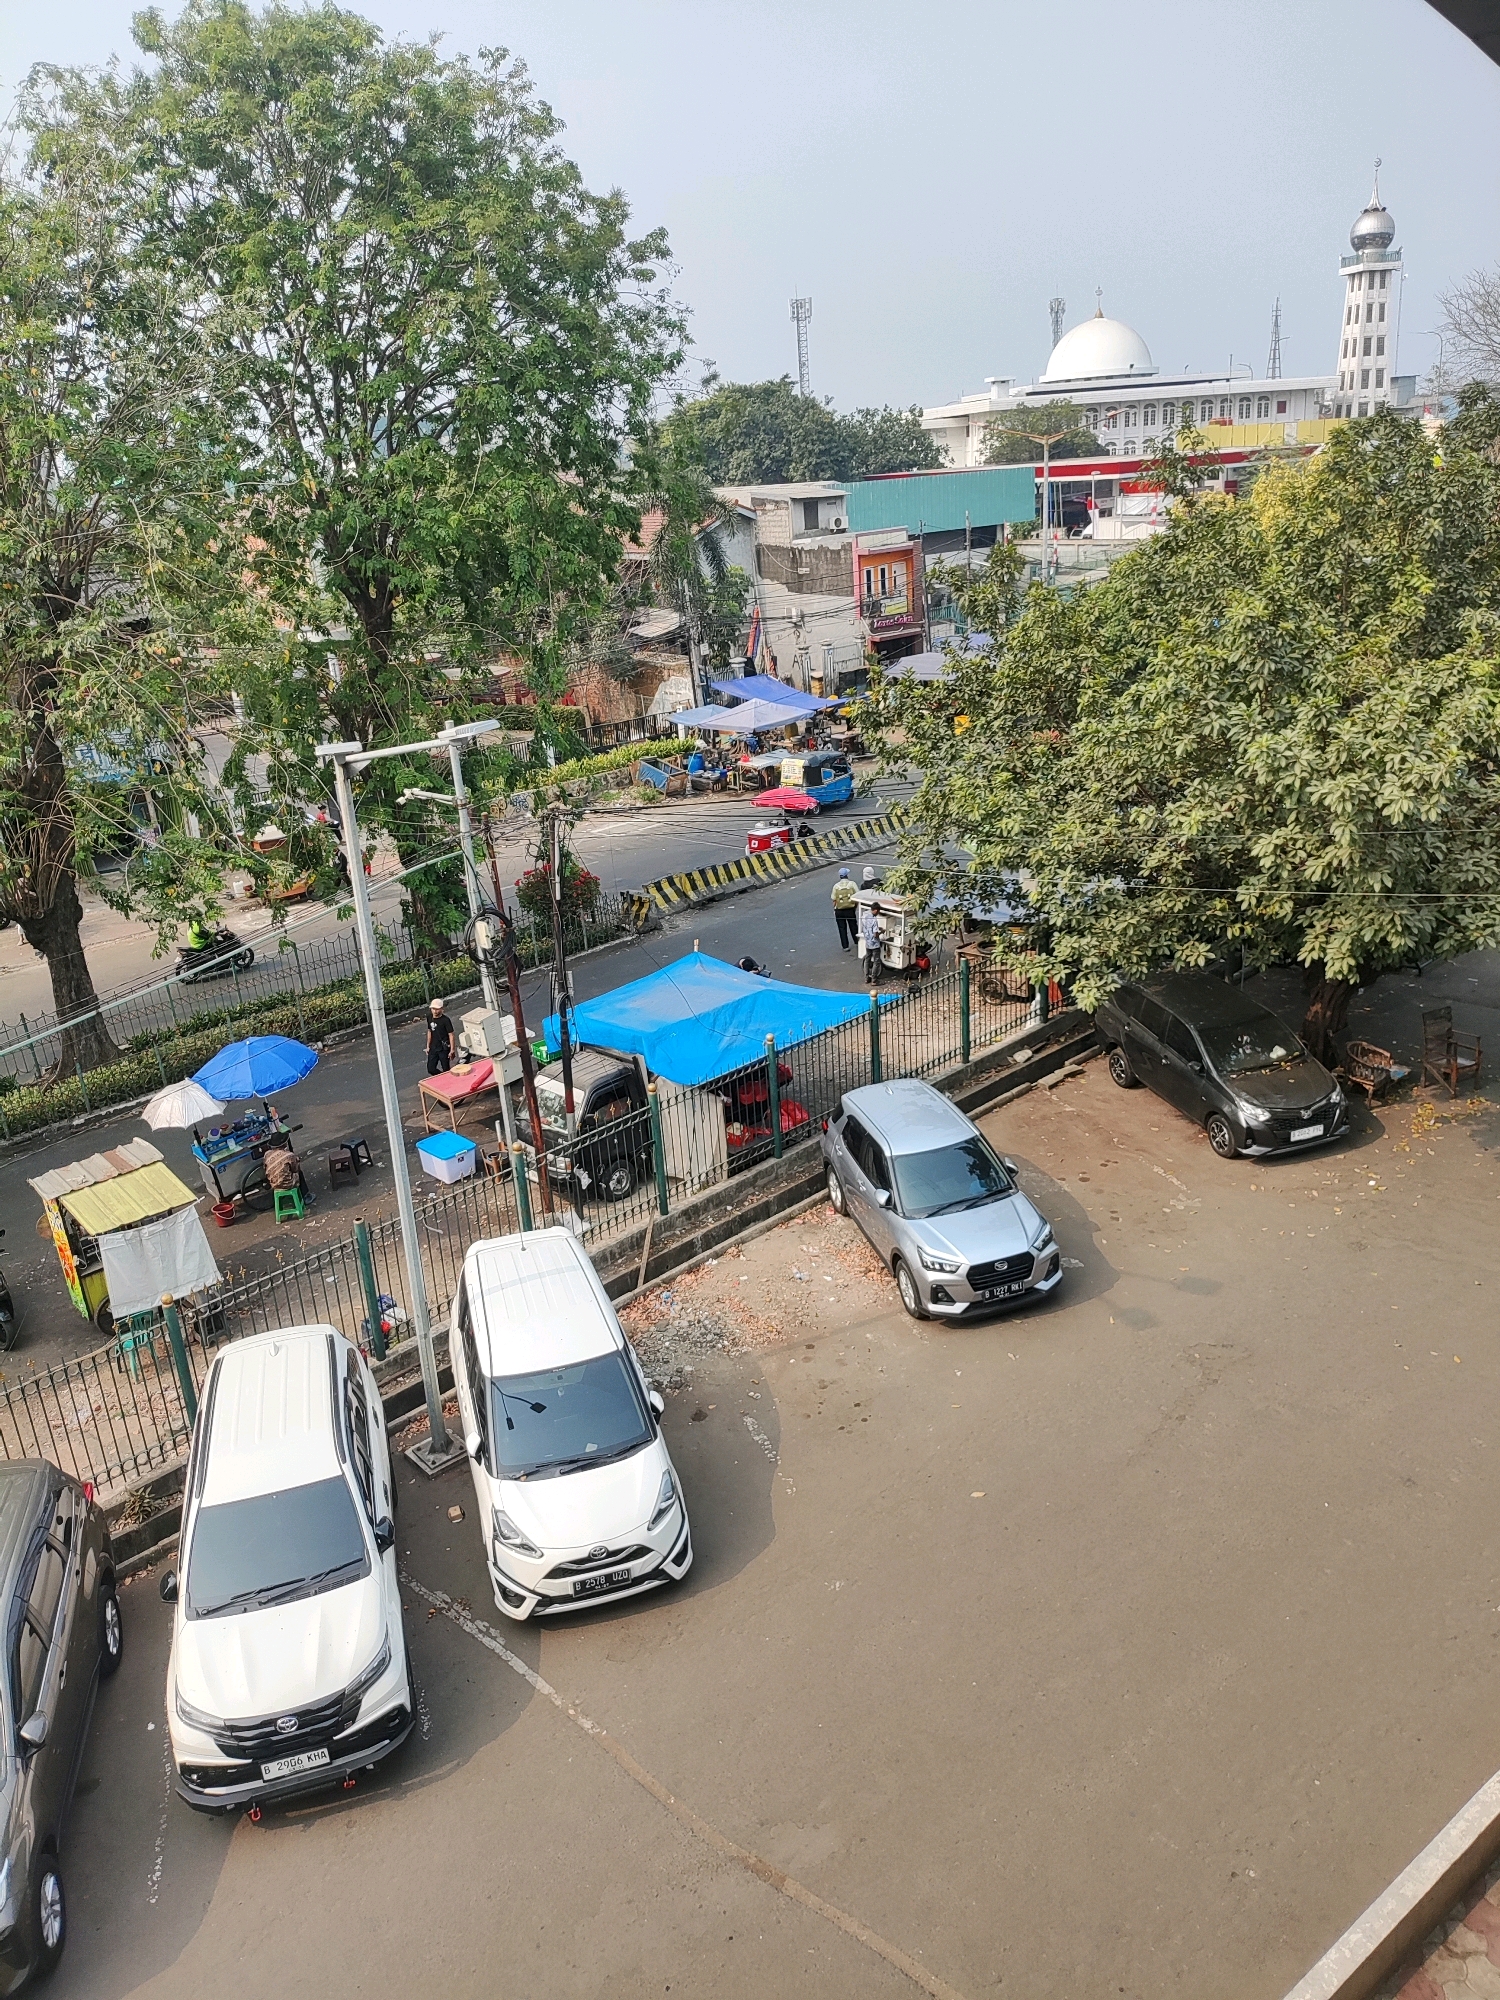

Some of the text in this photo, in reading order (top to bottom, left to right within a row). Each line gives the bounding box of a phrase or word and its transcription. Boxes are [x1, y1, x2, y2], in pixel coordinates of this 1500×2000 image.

[985, 1290, 989, 1298] B
[994, 1285, 1008, 1295] 1227
[575, 1582, 581, 1591] B
[585, 1575, 605, 1588] 2578
[264, 1765, 270, 1774] B
[277, 1757, 303, 1771] 2906
[307, 1751, 327, 1762] KHA
